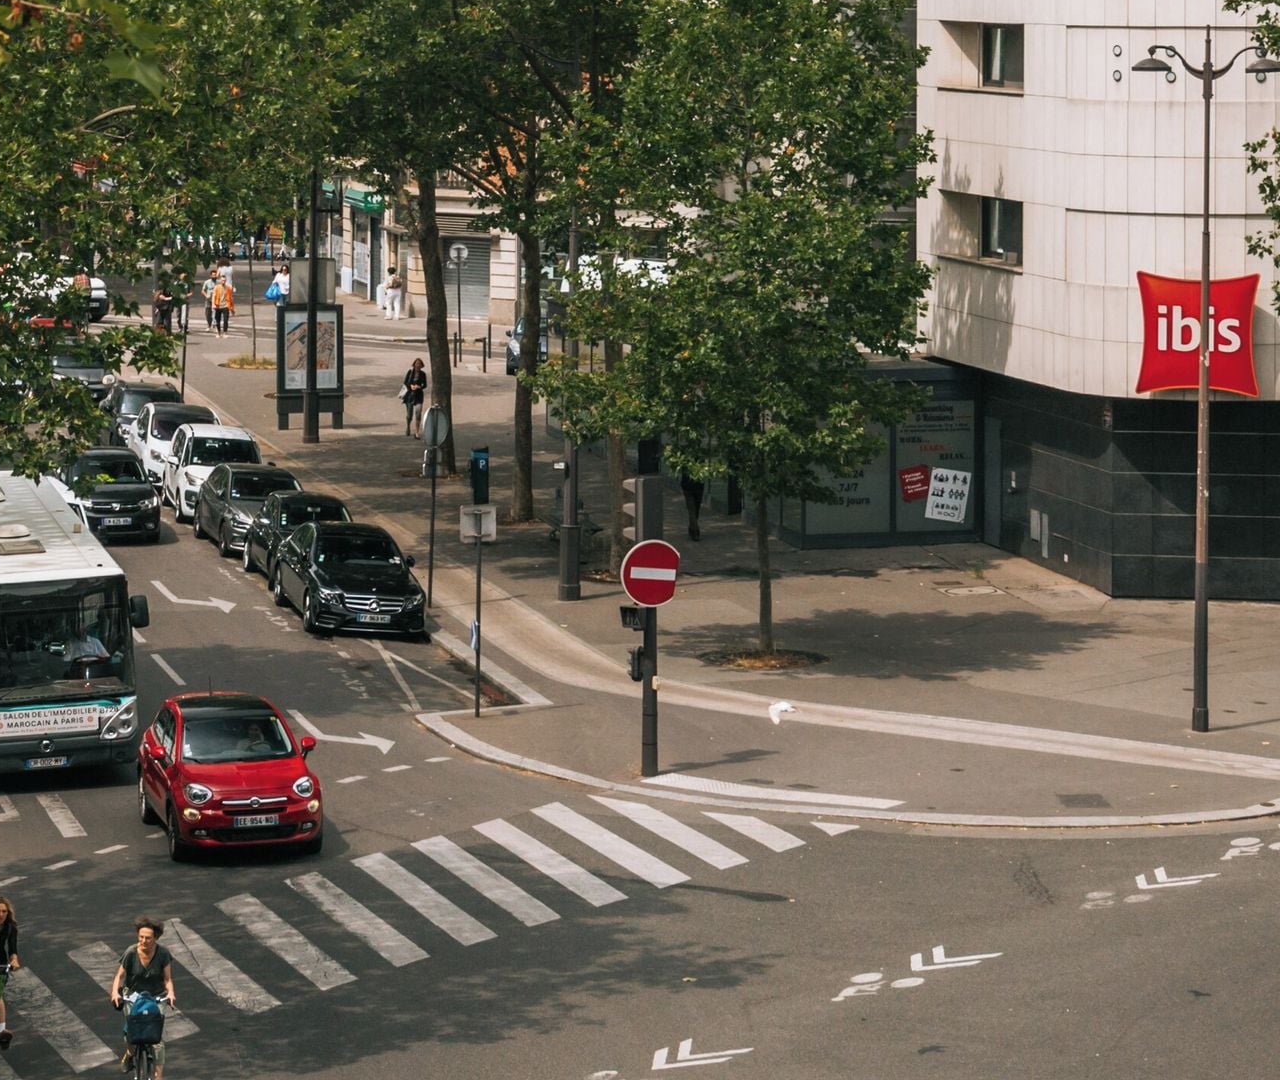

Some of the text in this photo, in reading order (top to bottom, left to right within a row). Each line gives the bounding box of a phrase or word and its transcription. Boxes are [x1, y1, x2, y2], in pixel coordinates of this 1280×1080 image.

[1157, 304, 1241, 353] ibis
[479, 459, 486, 469] P
[846, 495, 871, 507] jours
[3, 712, 30, 721] SALON
[31, 711, 42, 719] DE
[44, 707, 98, 718] L'IMMOBILIER
[6, 719, 51, 729] MAROCAIN
[61, 717, 84, 725] PARIS
